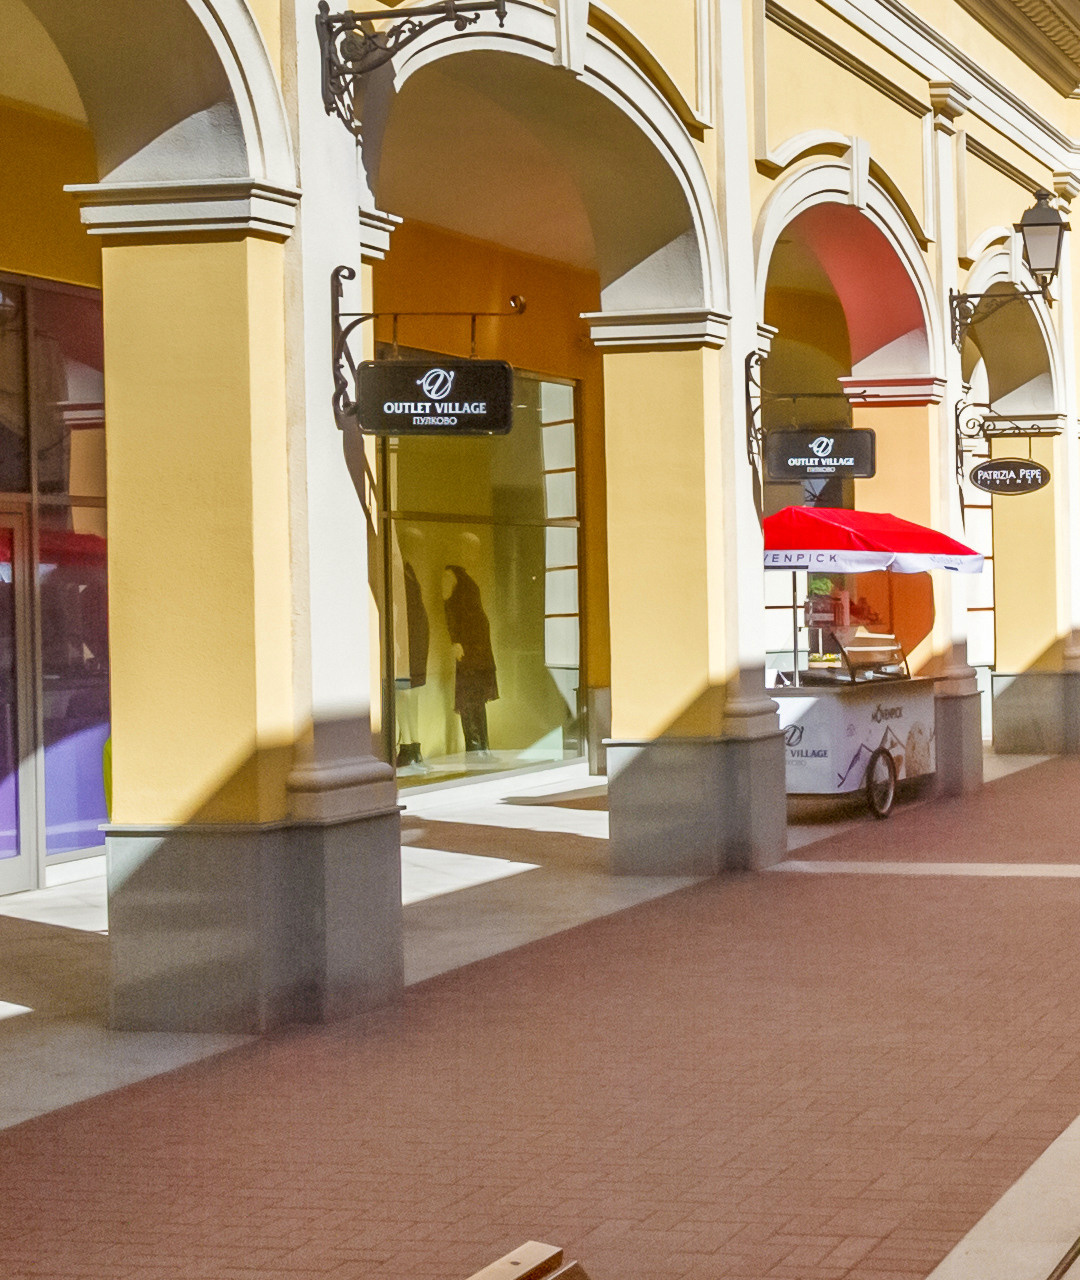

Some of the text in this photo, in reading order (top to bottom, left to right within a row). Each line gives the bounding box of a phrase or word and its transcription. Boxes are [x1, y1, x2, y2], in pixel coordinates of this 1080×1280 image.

[383, 402, 487, 414] OUTLET VILLAGE
[412, 416, 458, 425] ПУЛКОВО
[788, 457, 854, 466] OUTLET VILLAGE
[977, 468, 1042, 480] PATRIZIA PEPE
[790, 749, 829, 758] VILLAGE
